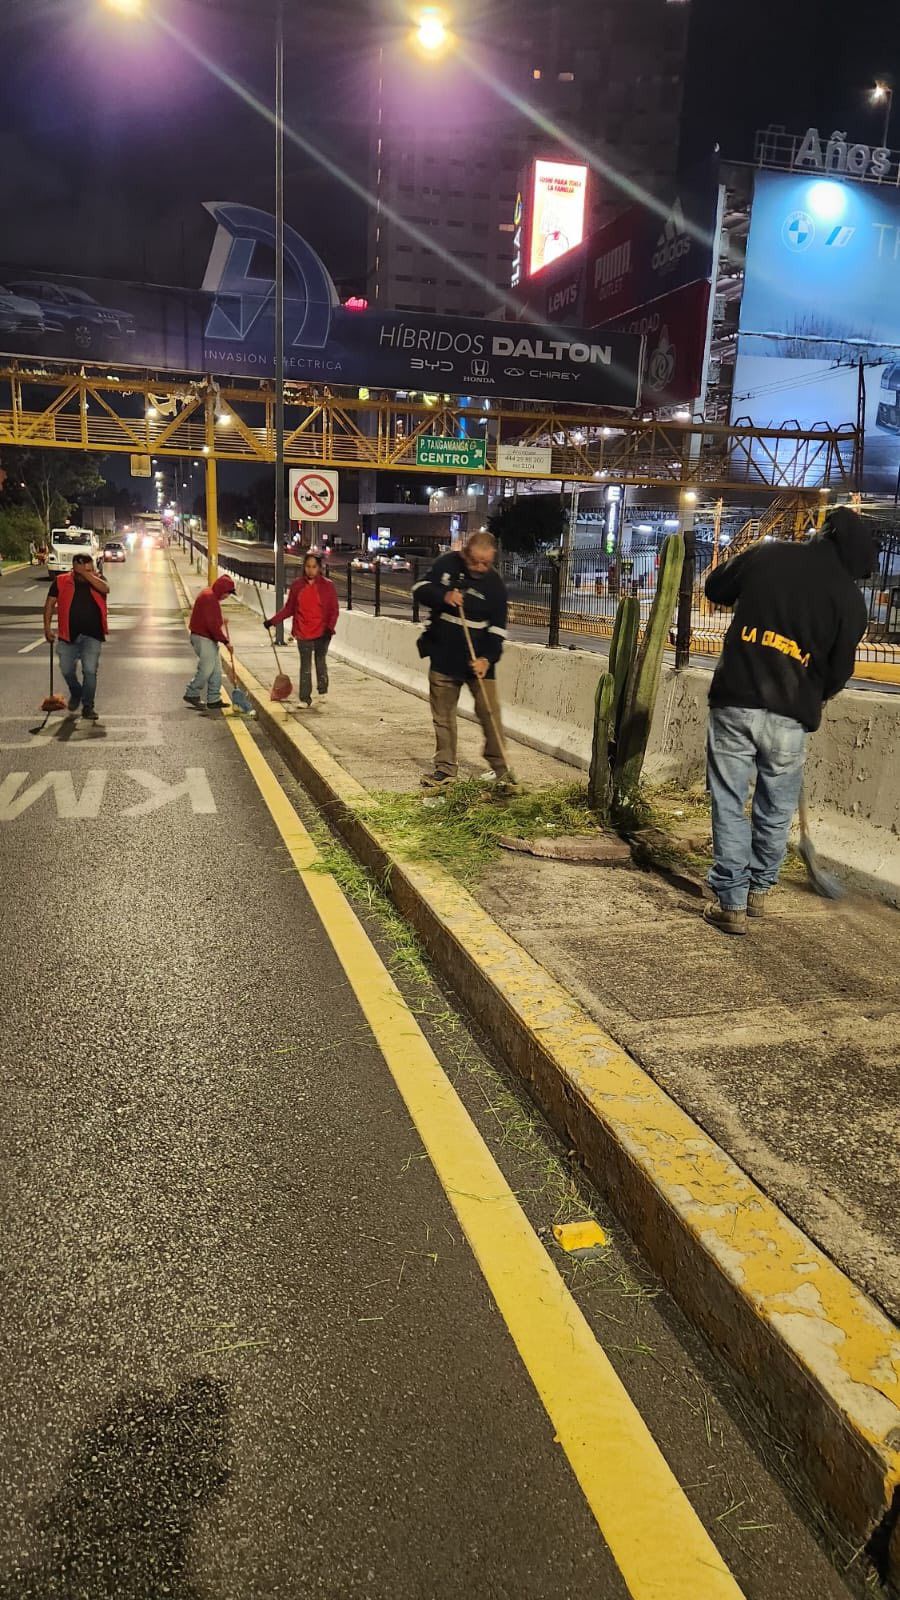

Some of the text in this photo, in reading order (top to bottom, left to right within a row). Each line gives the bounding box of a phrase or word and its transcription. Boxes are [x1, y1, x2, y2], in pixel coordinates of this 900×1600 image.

[795, 127, 892, 176] Años
[594, 239, 631, 288] PUMA
[652, 236, 691, 270] adidas
[379, 323, 612, 365] HÍBRIDOS DALTON
[463, 376, 496, 384] HONDA
[529, 369, 581, 381] CHIREY
[420, 452, 469, 465] CENTRO
[741, 626, 758, 643] LA
